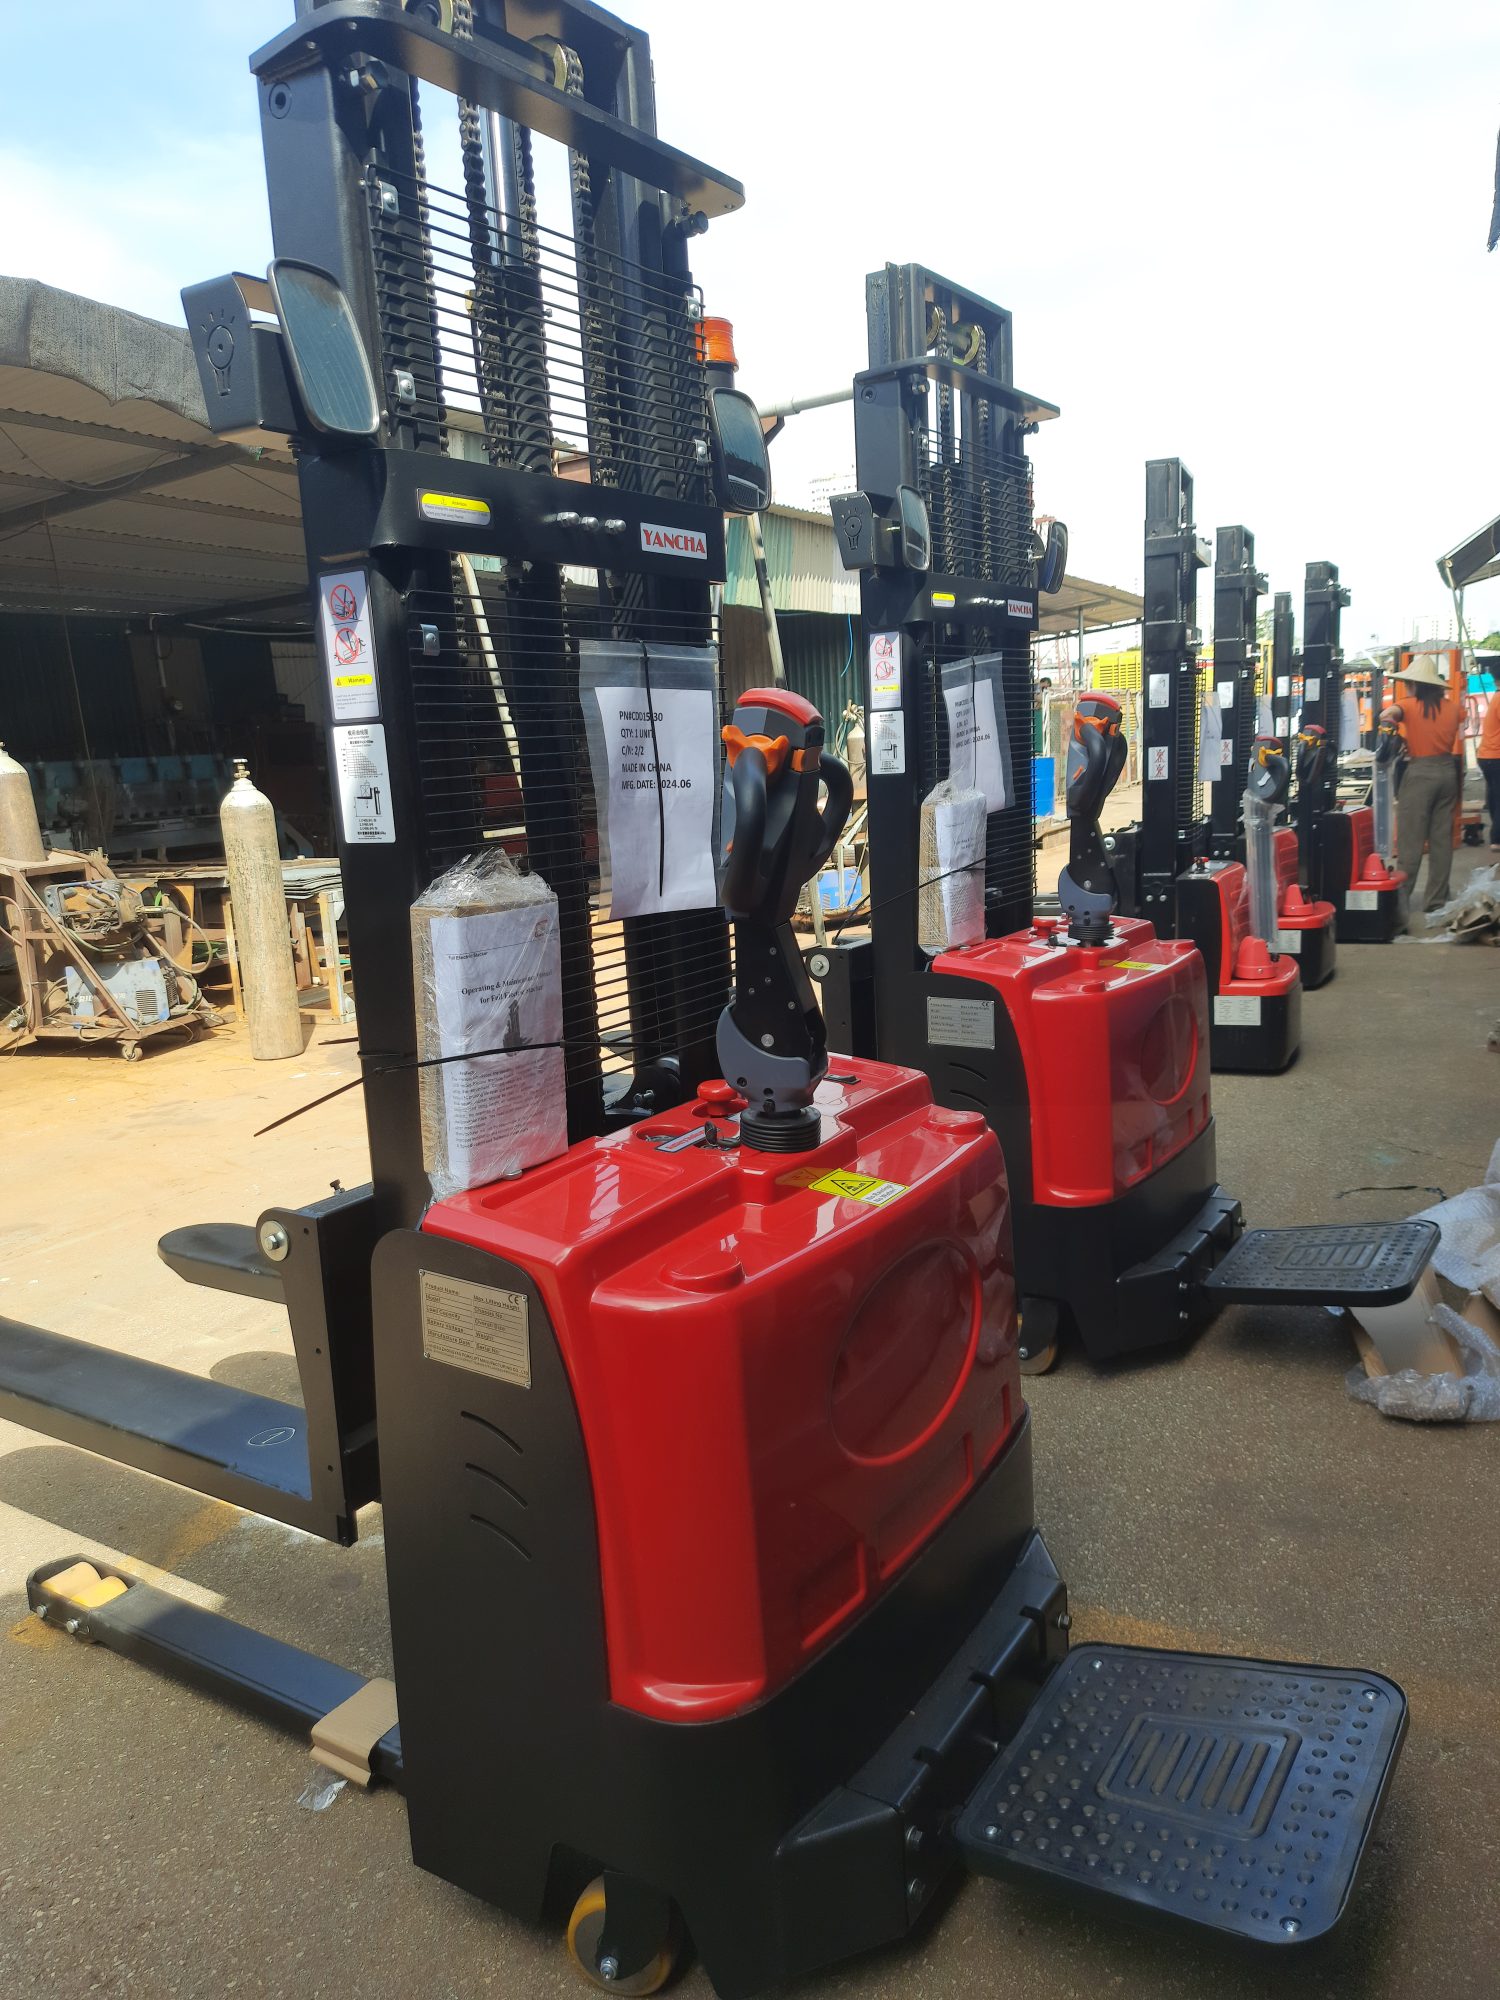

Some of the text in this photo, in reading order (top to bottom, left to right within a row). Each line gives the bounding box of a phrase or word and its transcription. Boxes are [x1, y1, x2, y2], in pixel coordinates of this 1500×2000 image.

[643, 528, 706, 553] YANCHA
[619, 711, 663, 721] PN#CDD1530
[620, 728, 634, 739] QTY:
[634, 746, 645, 757] 2/2
[621, 762, 672, 773] MADE IN CHNA
[636, 780, 656, 790] DATE:
[657, 779, 692, 789] 024.06
[461, 983, 495, 996] Operating
[495, 981, 501, 989] &
[480, 996, 490, 1004] for
[508, 1294, 520, 1306] CE
